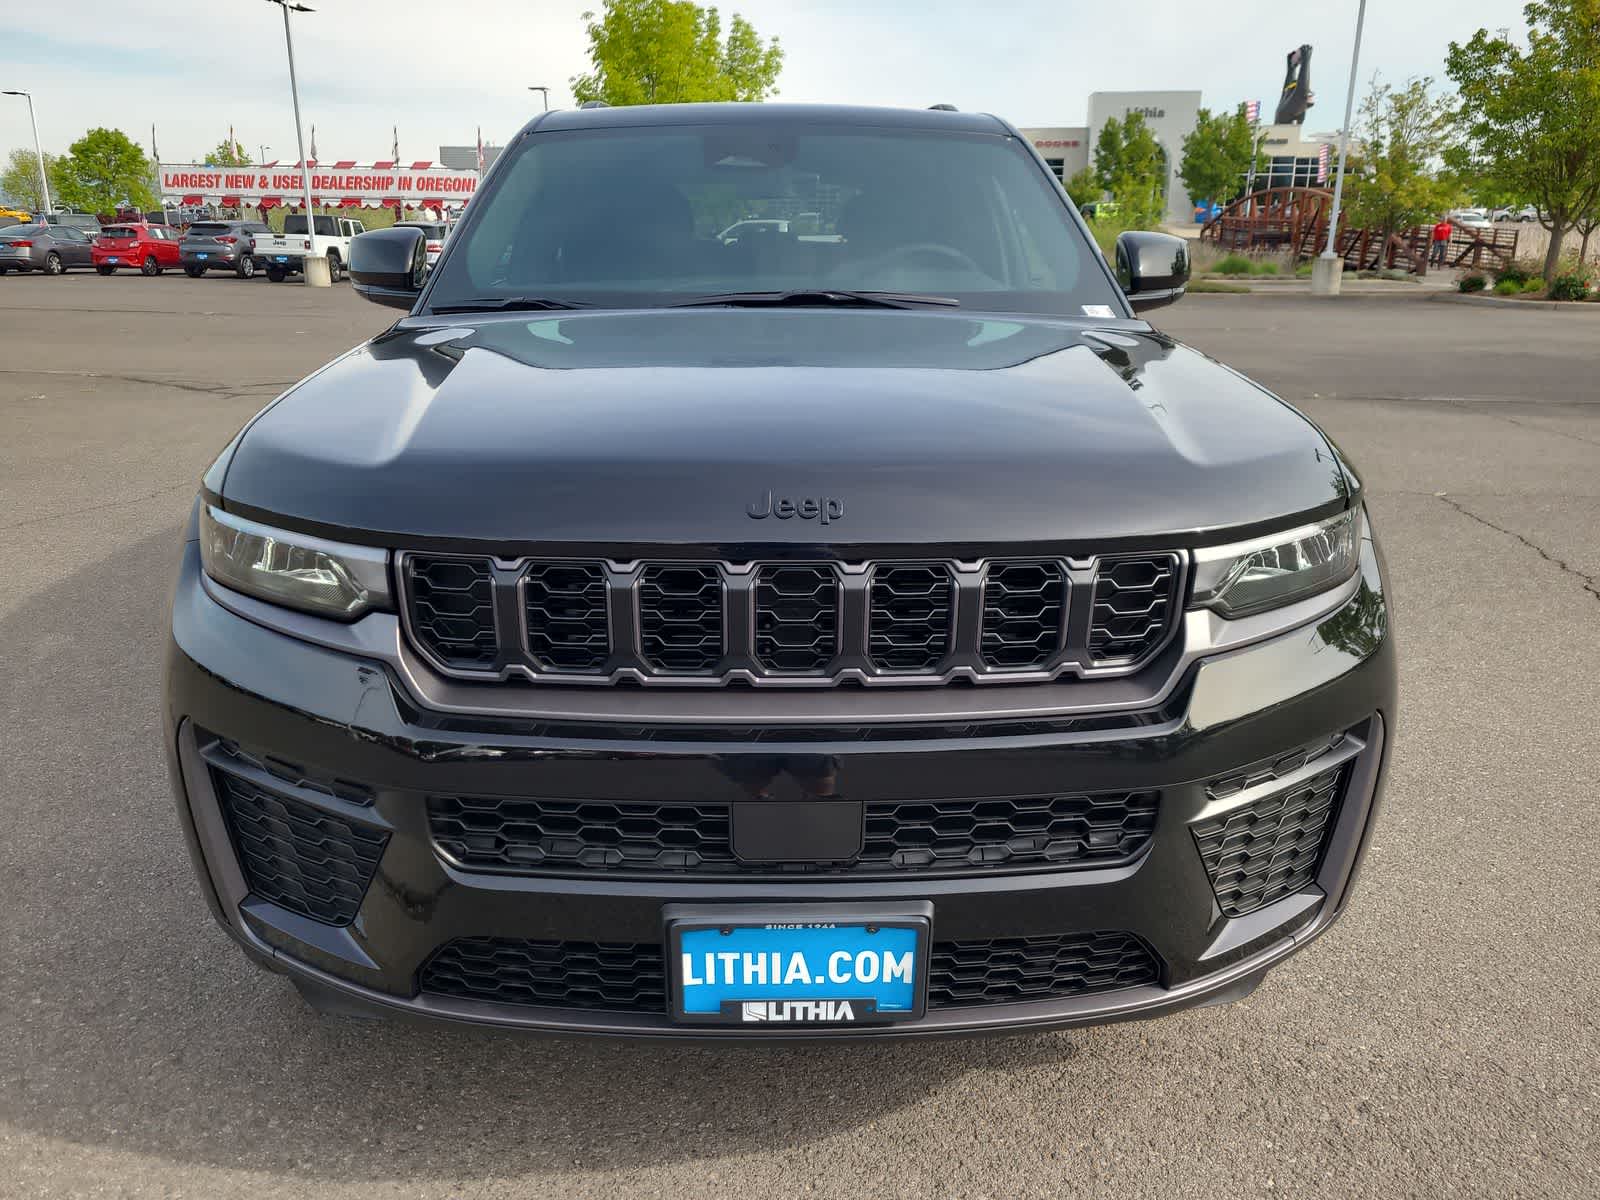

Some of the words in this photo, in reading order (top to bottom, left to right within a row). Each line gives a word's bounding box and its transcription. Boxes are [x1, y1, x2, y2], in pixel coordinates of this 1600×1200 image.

[164, 173, 222, 188] LARGEST
[225, 174, 255, 188] NEW
[259, 175, 269, 189] &
[312, 175, 394, 190] DEALERSHIP
[398, 176, 412, 190] IN
[416, 176, 477, 192] OREGON!
[747, 488, 844, 525] Jeep
[682, 951, 914, 986] LITHIA.COM
[766, 1000, 855, 1021] LITHIA
